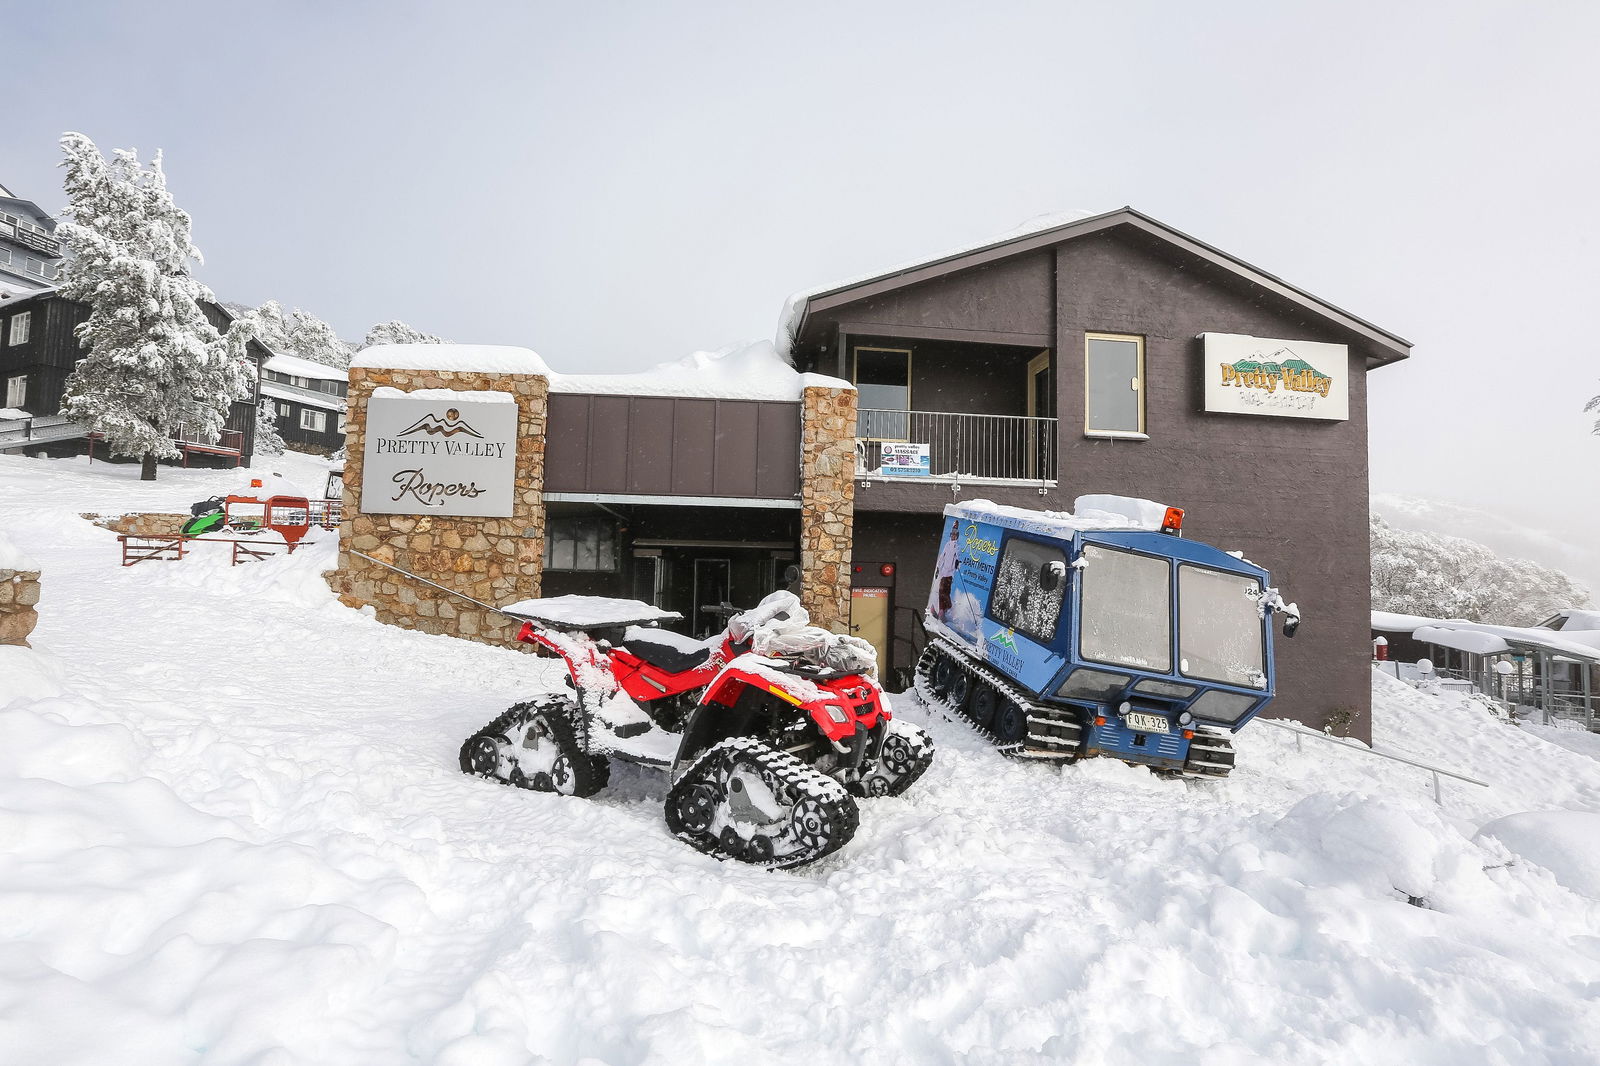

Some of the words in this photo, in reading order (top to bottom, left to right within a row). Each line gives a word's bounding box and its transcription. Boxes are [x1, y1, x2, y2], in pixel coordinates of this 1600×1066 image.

[1220, 363, 1279, 393] Pretty
[1280, 367, 1333, 398] Valley
[377, 438, 440, 454] PRETTY
[444, 440, 506, 458] VALLEY
[391, 467, 487, 506] Ropers
[961, 524, 999, 561] Ropers
[963, 557, 995, 575] APARTMENTS
[1002, 647, 1024, 673] VALLEY
